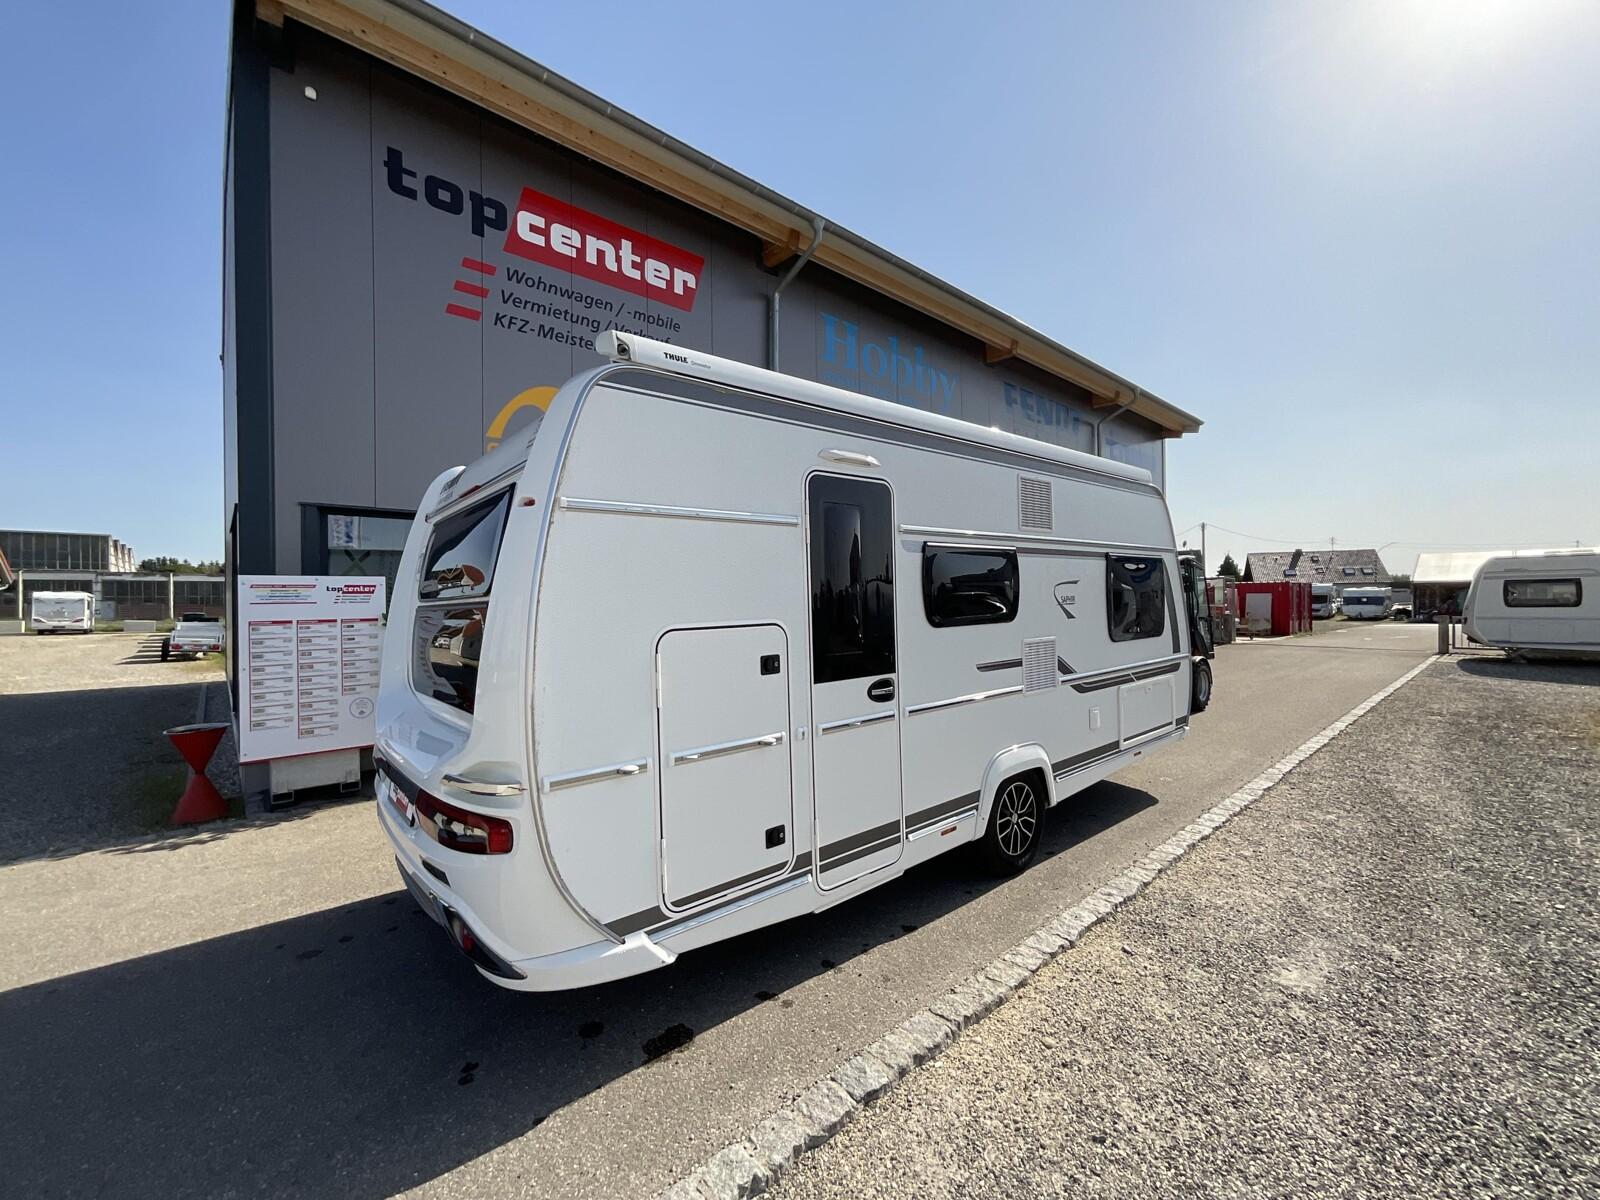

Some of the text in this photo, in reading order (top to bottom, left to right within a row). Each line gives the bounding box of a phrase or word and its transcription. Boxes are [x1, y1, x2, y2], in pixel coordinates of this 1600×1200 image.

[501, 289, 601, 333] Vermietung
[506, 267, 614, 313] Wohnwagen
[493, 312, 597, 351] KFZ-Meiste
[663, 351, 689, 364] THULE
[820, 312, 959, 412] Hobby
